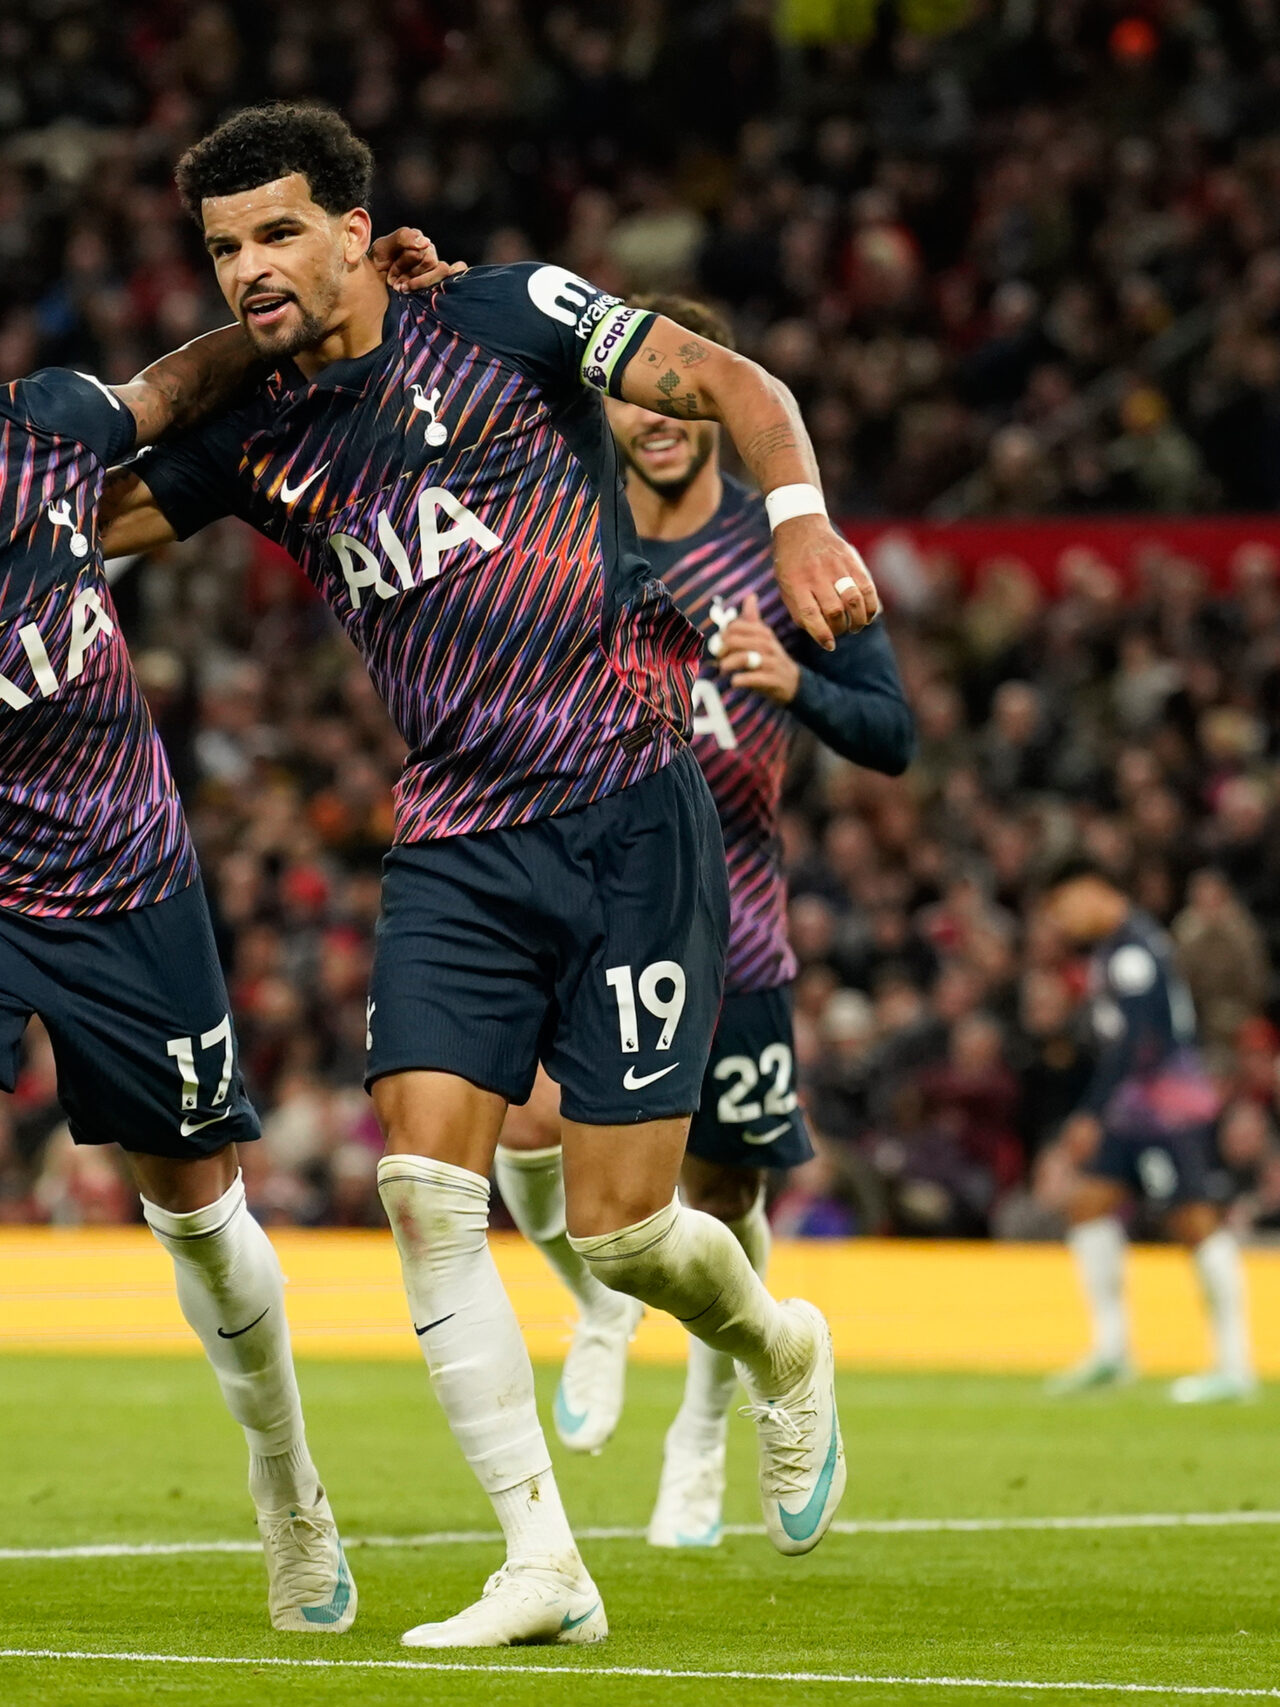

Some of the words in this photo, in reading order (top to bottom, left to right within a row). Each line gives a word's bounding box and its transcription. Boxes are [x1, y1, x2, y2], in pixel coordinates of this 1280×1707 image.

[329, 486, 503, 609] AIA
[605, 960, 686, 1053] 19
[166, 1013, 233, 1111] 17
[713, 1042, 798, 1123] 22
